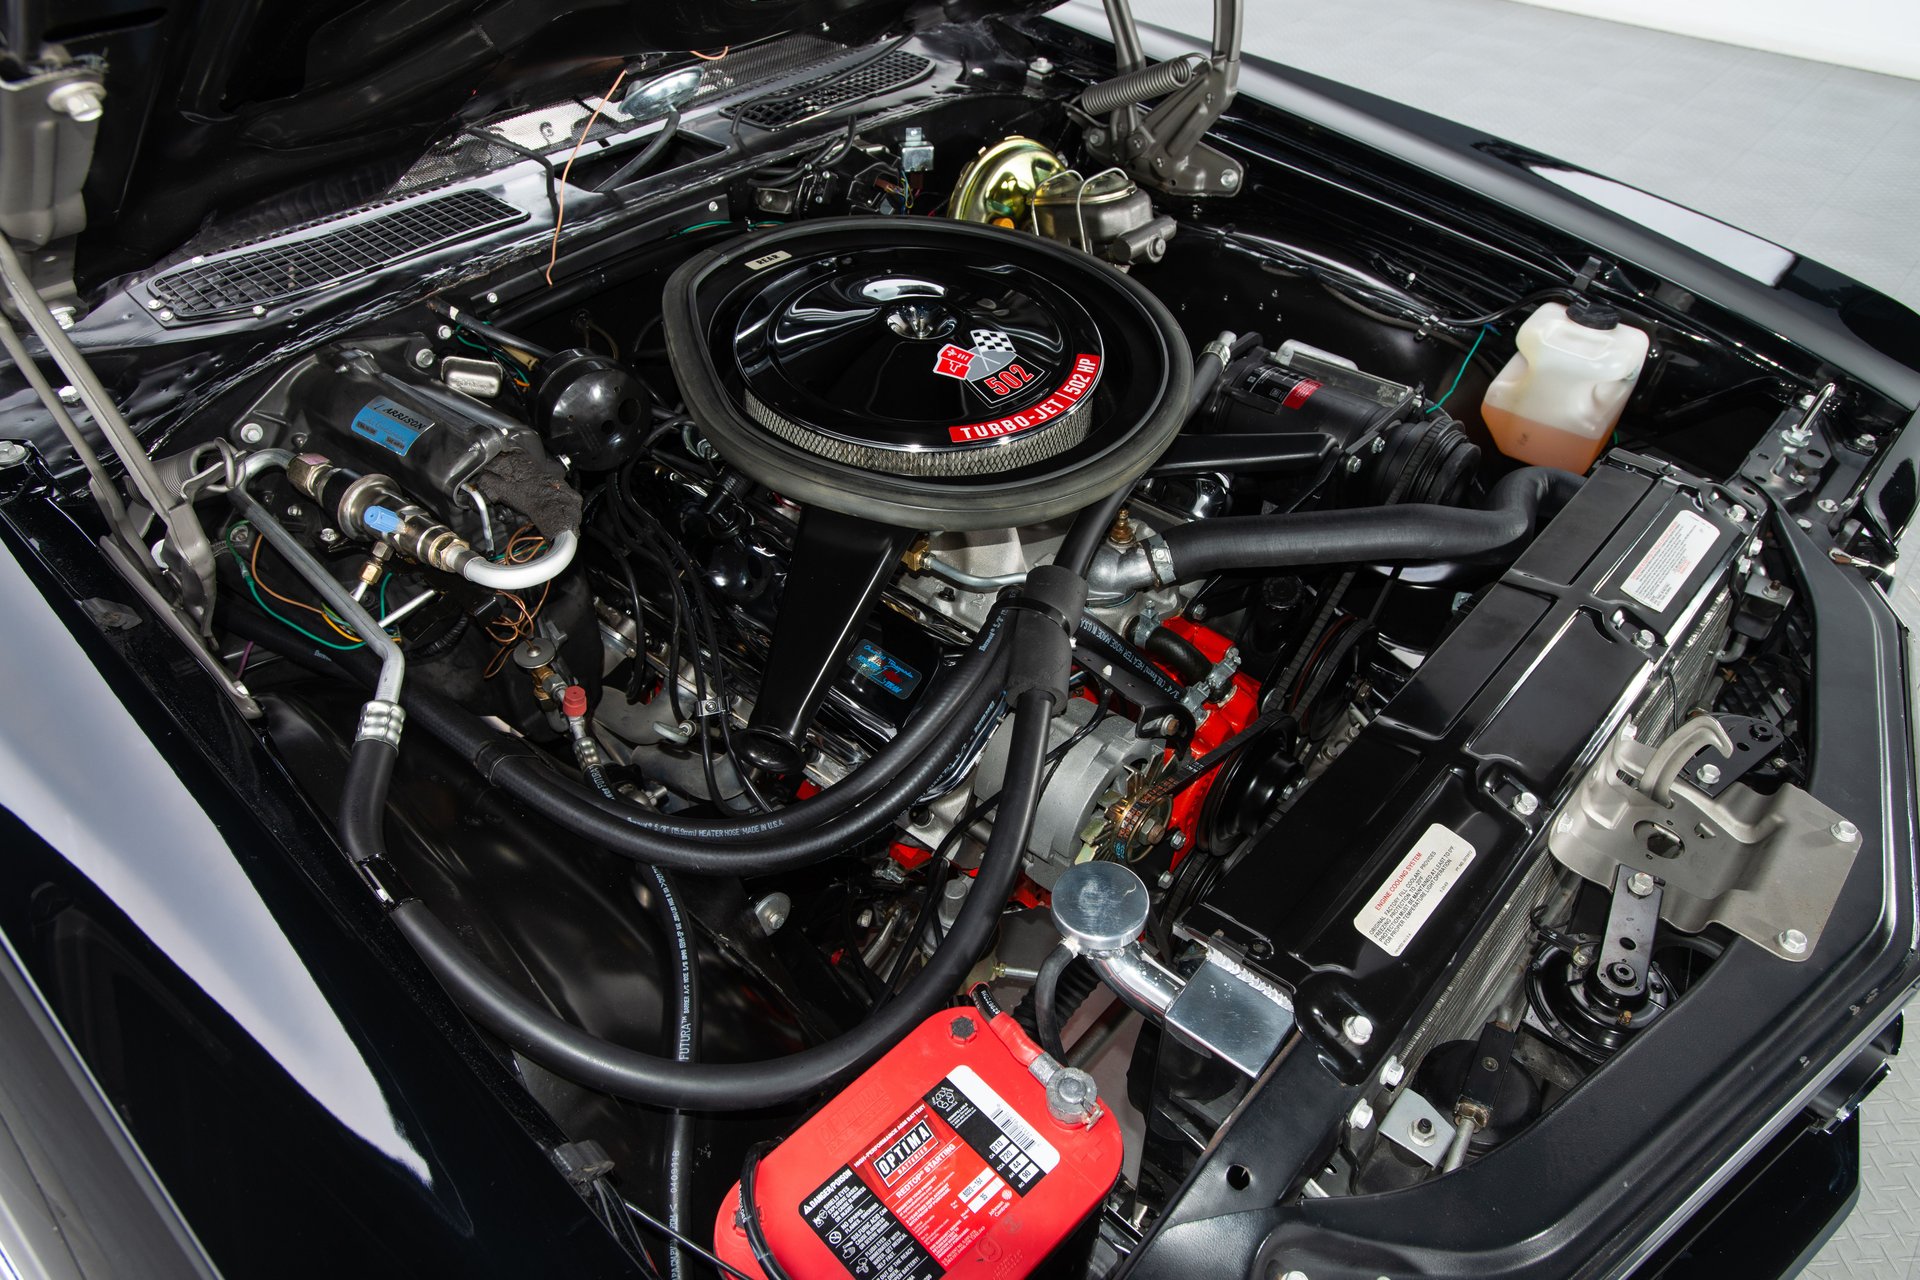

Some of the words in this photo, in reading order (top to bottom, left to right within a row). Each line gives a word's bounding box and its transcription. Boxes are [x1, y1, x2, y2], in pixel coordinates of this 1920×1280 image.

[756, 254, 780, 264] REAR
[1077, 358, 1096, 373] HP
[984, 364, 1034, 395] 502
[1068, 374, 1091, 395] 502
[960, 398, 1065, 438] TURBO-JET
[1095, 629, 1112, 645] MADE
[1108, 639, 1125, 655] HOSE
[1121, 649, 1146, 671] HEATER
[699, 828, 723, 836] HEATER
[725, 827, 740, 835] HOSE
[742, 824, 760, 834] MADE
[1369, 915, 1386, 935] ORIGINAL
[1384, 897, 1401, 916] FACTORY
[1399, 888, 1408, 897] FILL
[1405, 870, 1422, 889] COOLANT
[1420, 851, 1437, 870] PROVIDES
[1375, 890, 1393, 911] ENGINE
[1389, 869, 1409, 893] COOLING
[1405, 852, 1424, 872] SYSTEM
[1378, 915, 1402, 943] PROTECTION
[1398, 904, 1410, 917] MUST
[1434, 857, 1447, 871] LEAST
[1374, 918, 1392, 939] FREEZING
[1389, 893, 1412, 919] PROTECTION
[1383, 936, 1393, 946] FOR
[1390, 919, 1406, 938] PROPER
[1402, 891, 1428, 921] TEMPERATURE
[897, 1119, 909, 1131] AGM
[906, 1104, 927, 1122] BATTERY
[877, 1124, 931, 1176] OPTIMA
[923, 1142, 956, 1174] STARTING
[988, 1152, 996, 1160] CA
[991, 1140, 1004, 1152] 910
[897, 1146, 928, 1175] BATTERIES
[996, 1162, 1006, 1172] CCA
[1001, 1149, 1013, 1162] 720
[1012, 1160, 1022, 1170] 44
[1021, 1169, 1032, 1179] 90
[809, 1168, 853, 1209] DANGER/POISON
[823, 1194, 841, 1211] SHIELD
[838, 1185, 850, 1198] EYES
[827, 1196, 848, 1215] EXPLOSIVE
[845, 1186, 859, 1198] GASES
[831, 1210, 840, 1219] CAN
[838, 1201, 850, 1213] CAUSE
[848, 1186, 867, 1204] BLINDNESS
[834, 1215, 842, 1223] OR
[840, 1204, 855, 1218] INJURY
[860, 1202, 879, 1220] SMOKING
[840, 1222, 849, 1230] NO
[850, 1221, 872, 1242] SULFURIC
[869, 1213, 881, 1225] ACID
[879, 1207, 888, 1216] CAN
[854, 1233, 868, 1246] CAUSE
[865, 1217, 886, 1236] BLINDNESS
[864, 1231, 879, 1245] SEVERE
[876, 1221, 890, 1234] BURNS
[864, 1244, 878, 1258] FLUSH
[876, 1236, 887, 1247] EYES
[868, 1239, 893, 1262] IMMEDIATELY
[890, 1230, 901, 1241] WITH
[884, 1245, 894, 1254] GET
[891, 1232, 908, 1248] MEDICAL
[876, 1259, 888, 1271] HELP
[879, 1270, 890, 1280] OUT
[887, 1265, 895, 1273] OF
[892, 1258, 903, 1268] THE
[900, 1246, 915, 1260] REACH
